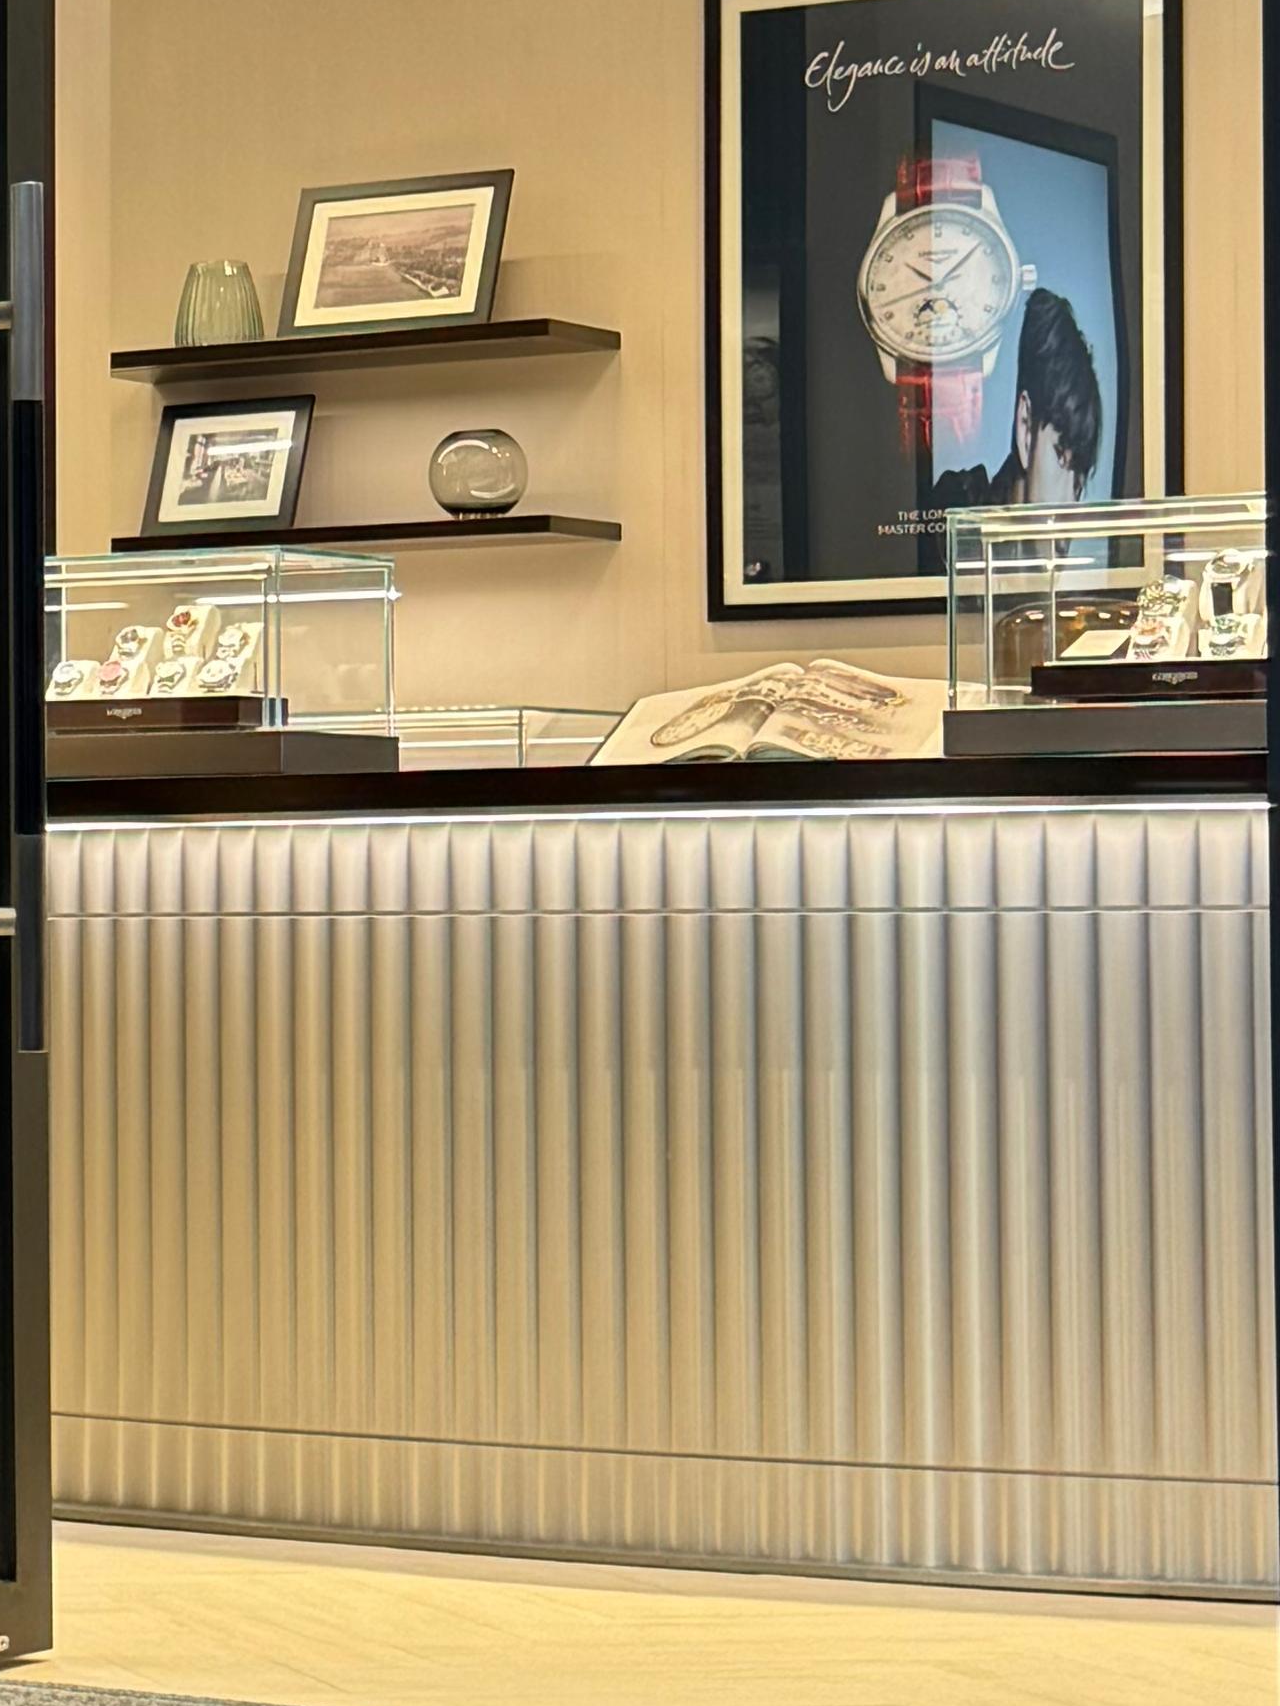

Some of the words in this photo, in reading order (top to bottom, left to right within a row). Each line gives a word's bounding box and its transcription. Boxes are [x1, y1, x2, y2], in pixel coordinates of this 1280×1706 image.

[804, 40, 906, 112] Elegance
[909, 41, 931, 77] is
[934, 49, 966, 77] an
[965, 27, 1075, 75] attitude
